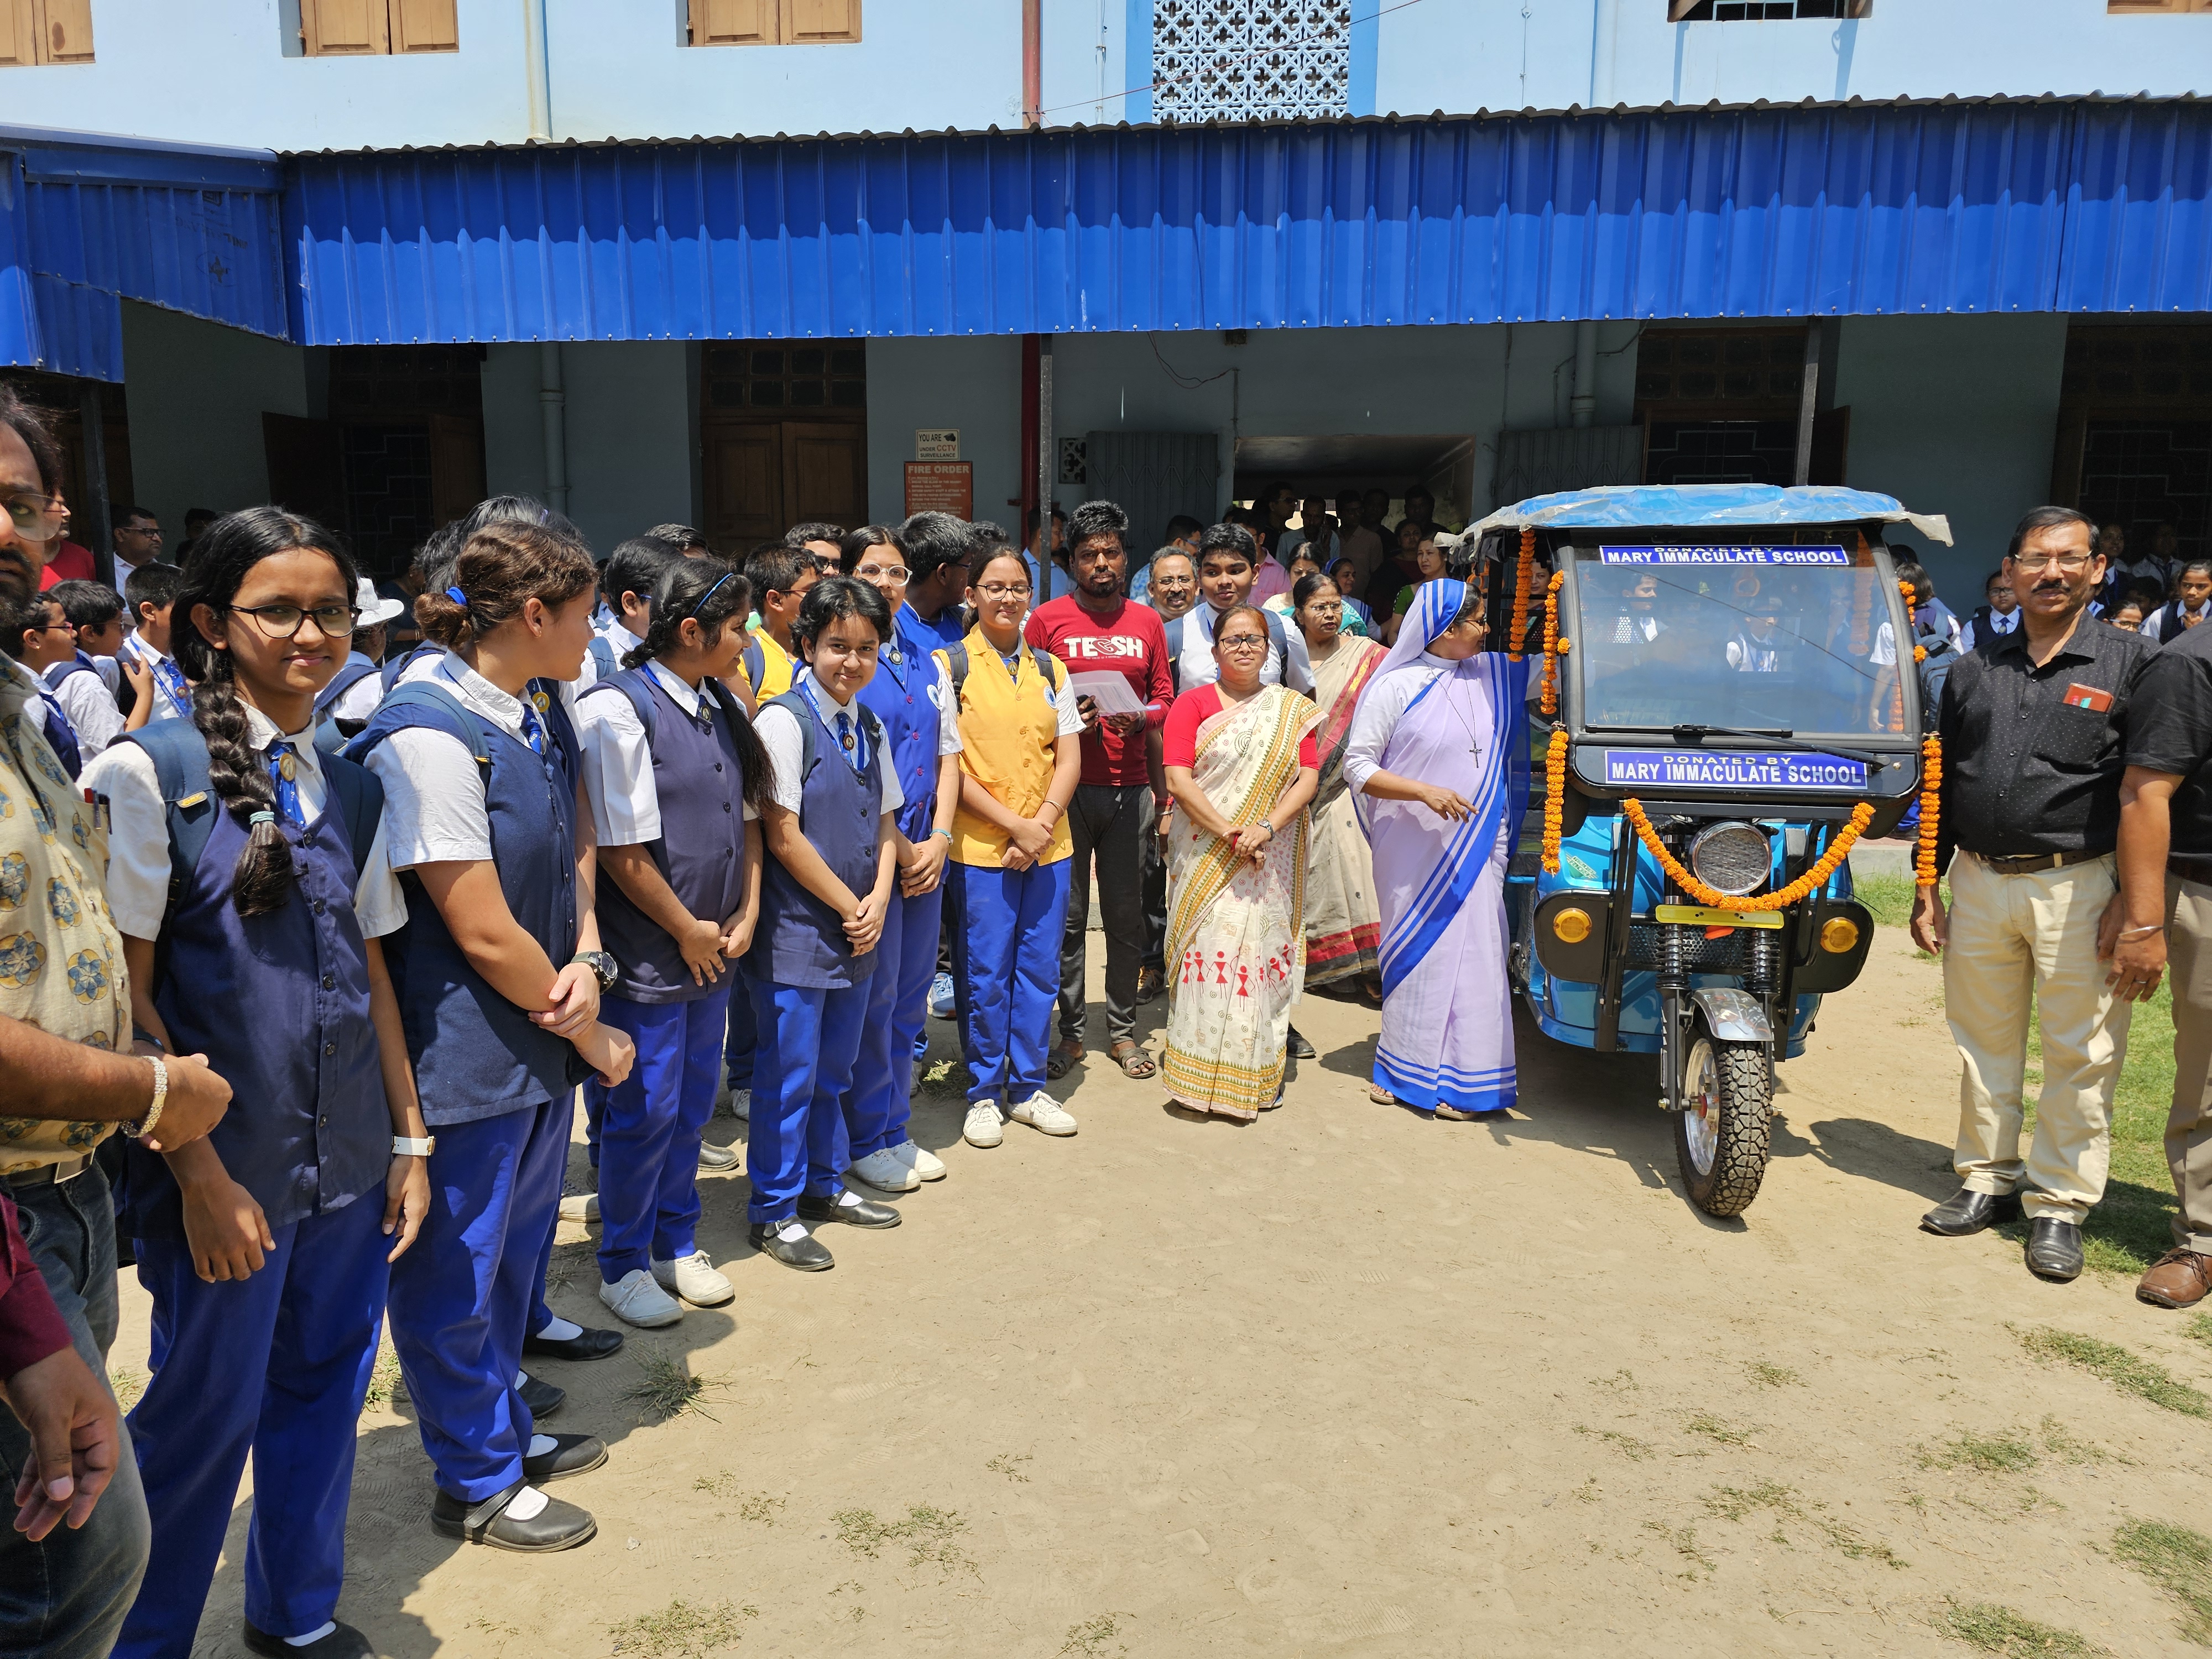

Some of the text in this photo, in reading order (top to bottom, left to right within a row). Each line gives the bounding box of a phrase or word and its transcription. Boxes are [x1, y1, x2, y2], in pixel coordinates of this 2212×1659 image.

[1608, 551, 1843, 562] MARY IMMACULATE SCHOOL
[529, 733, 538, 743] MIS
[1663, 756, 1756, 765] DONATED
[1613, 763, 1861, 783] MARY IMMACULATE SCHOOL
